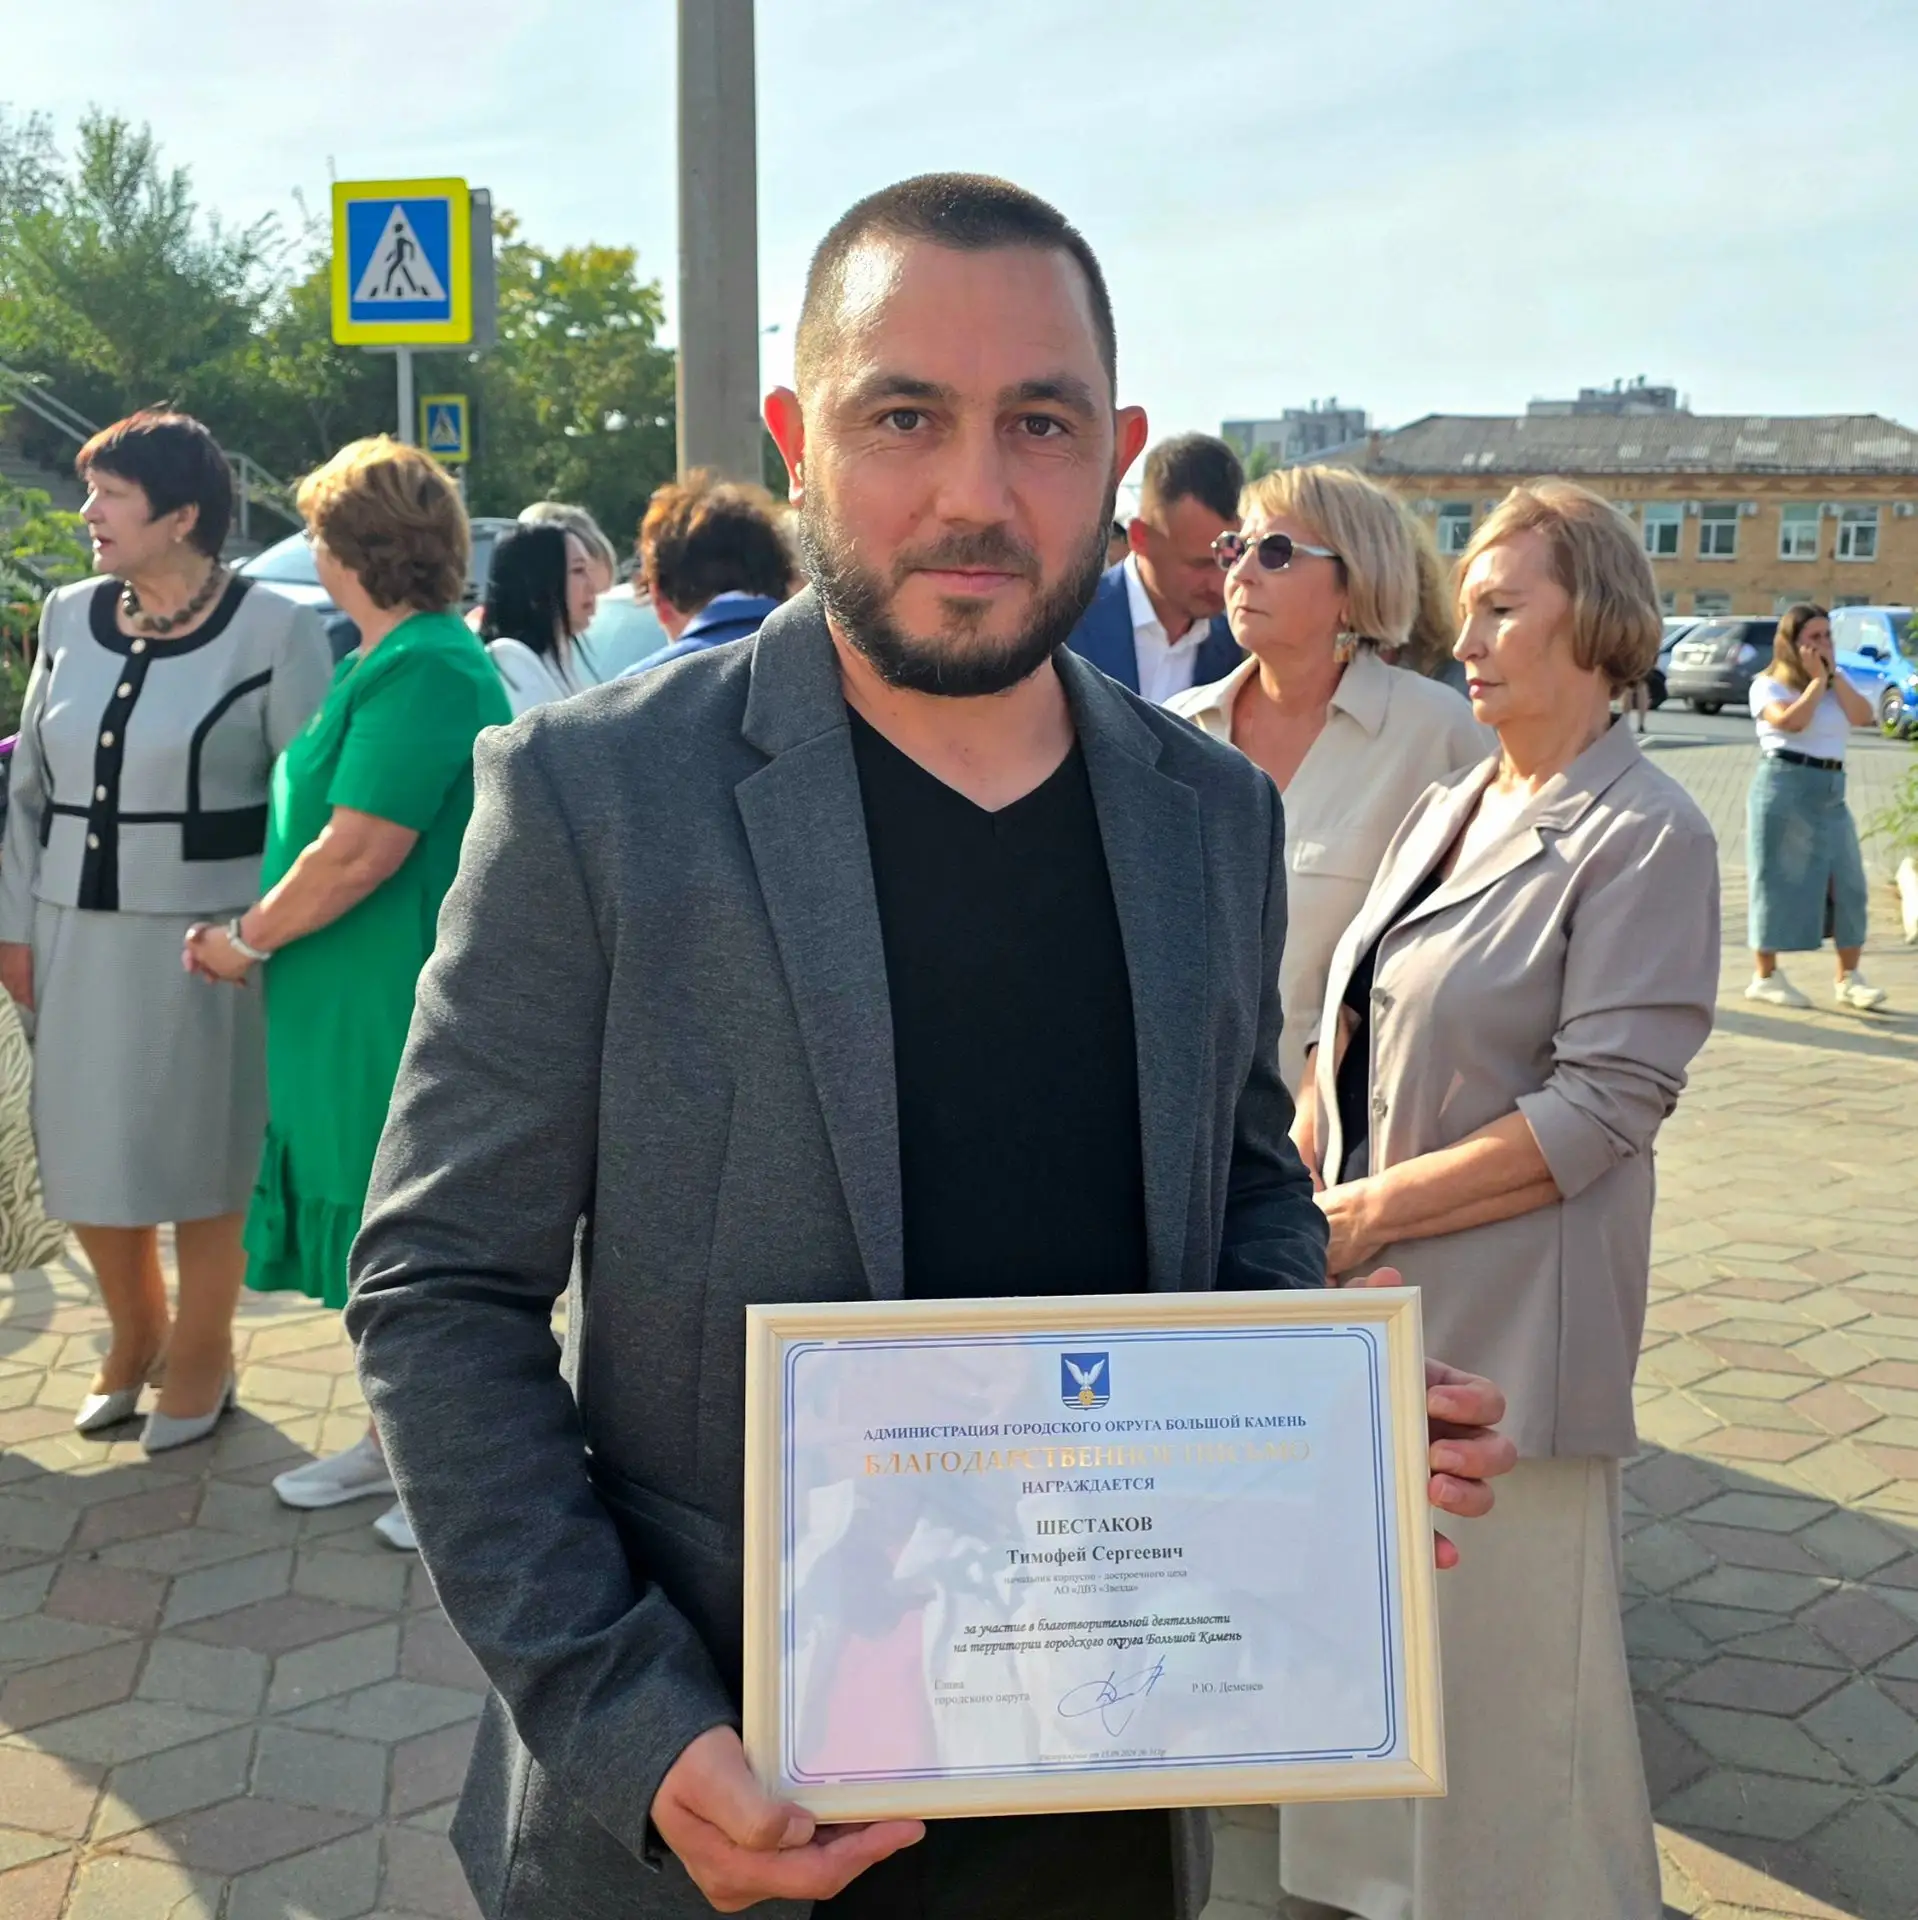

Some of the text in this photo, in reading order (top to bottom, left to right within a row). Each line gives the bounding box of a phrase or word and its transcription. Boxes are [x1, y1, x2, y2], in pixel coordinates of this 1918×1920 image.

[863, 1414, 1307, 1441] АДМИНИСТРАЦИЯ ГОРОДСКОГО ОКРУГА БОЛЬШОЙ КАМЕНЬ
[1021, 1477, 1156, 1495] НАГРАЖДАЕТСЯ
[1036, 1516, 1153, 1535] ШЕСТАКОВ
[1006, 1545, 1184, 1567] Тимофей Сергеевич
[1053, 1585, 1070, 1596] АО
[964, 1624, 976, 1634] за
[978, 1623, 1026, 1637] участие
[1037, 1614, 1149, 1633] благотворительной
[1151, 1613, 1231, 1627] деятельности
[953, 1631, 1242, 1655] на территории городского округа Большой Камень
[934, 1692, 1031, 1707] городского округа
